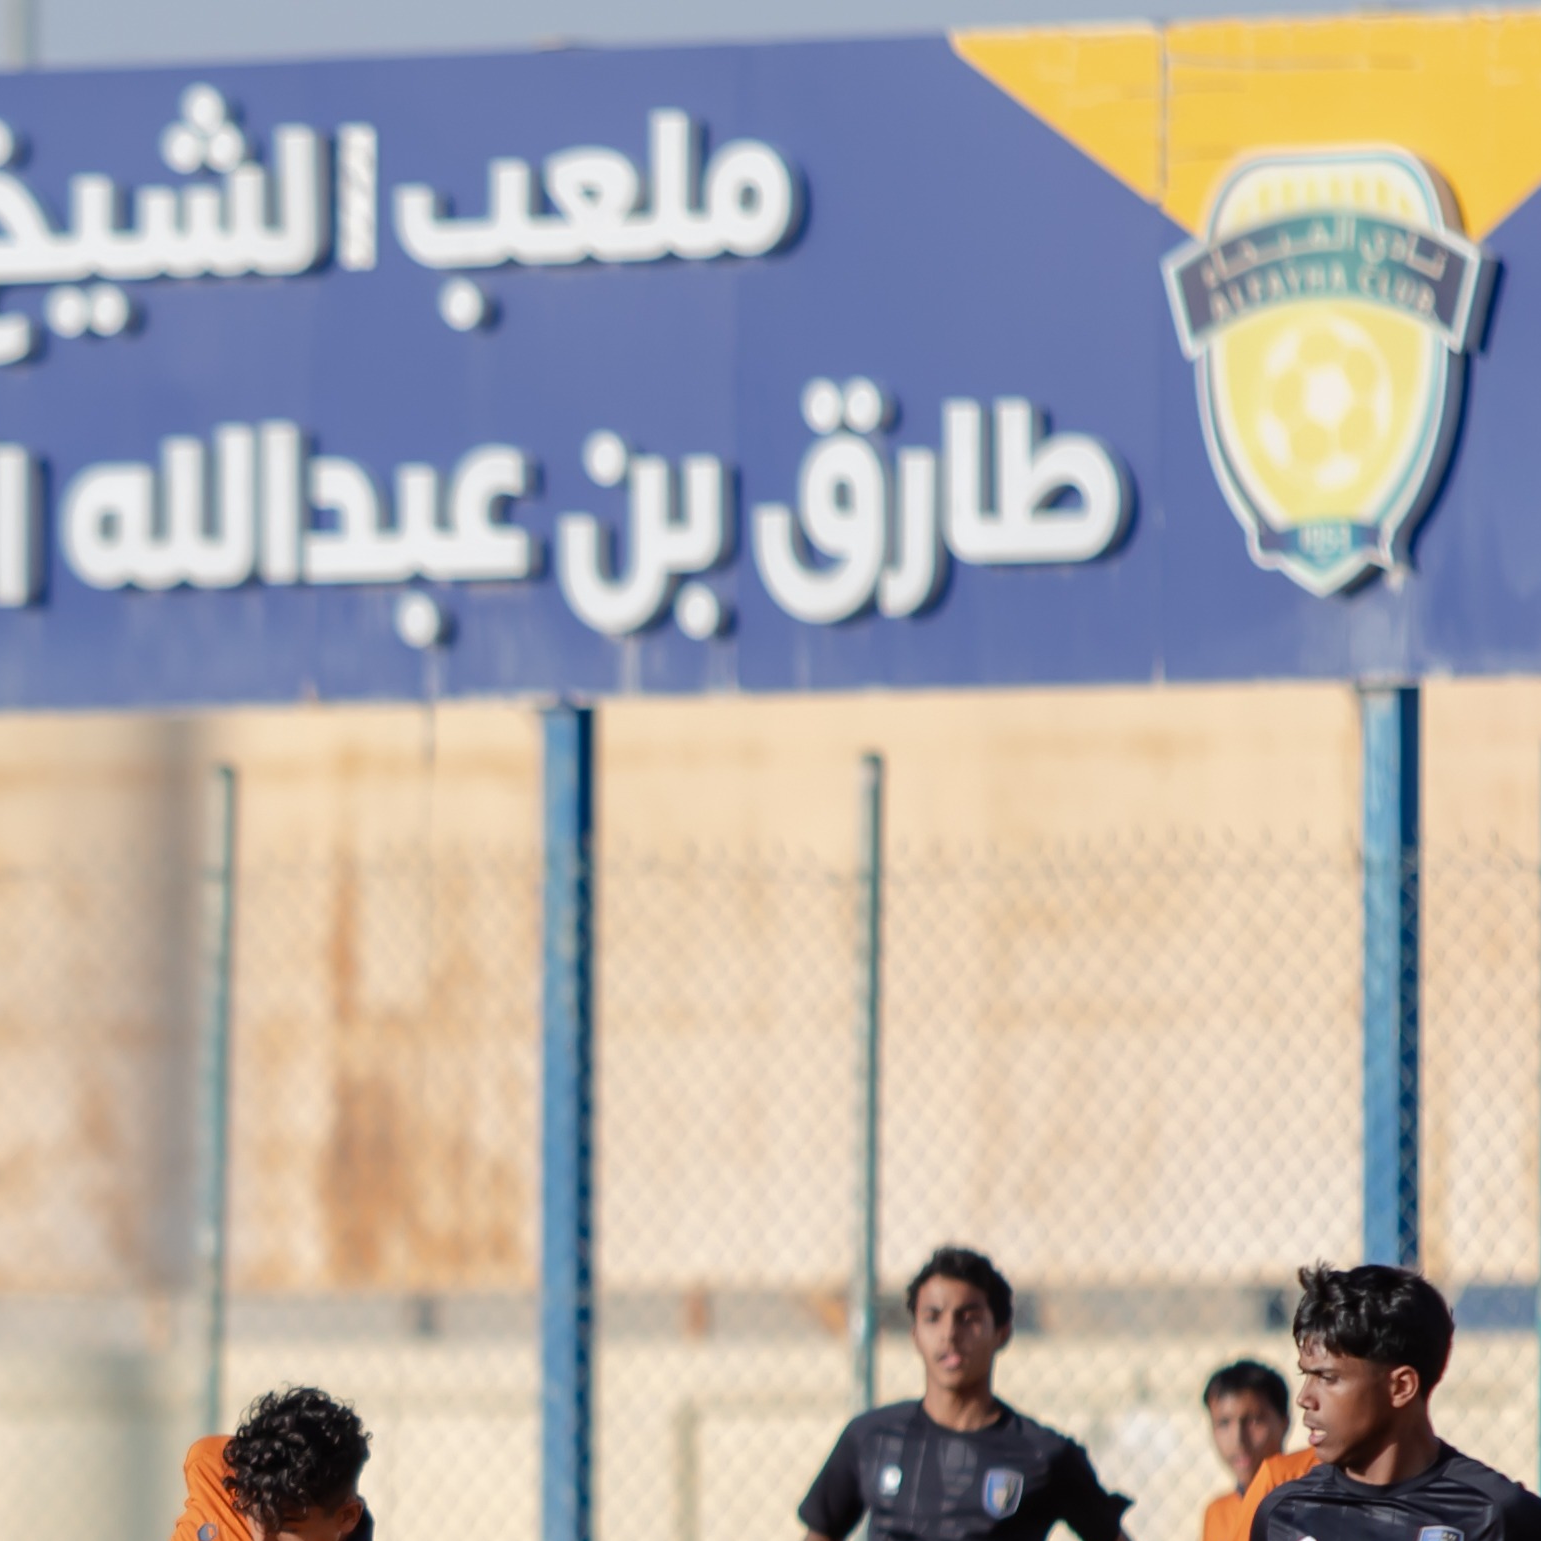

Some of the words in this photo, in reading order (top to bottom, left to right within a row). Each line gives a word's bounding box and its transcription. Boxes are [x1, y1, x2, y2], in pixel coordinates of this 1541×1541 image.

[392, 108, 794, 332] ملعب
[556, 429, 725, 640] بن
[752, 375, 1123, 624] طارق
